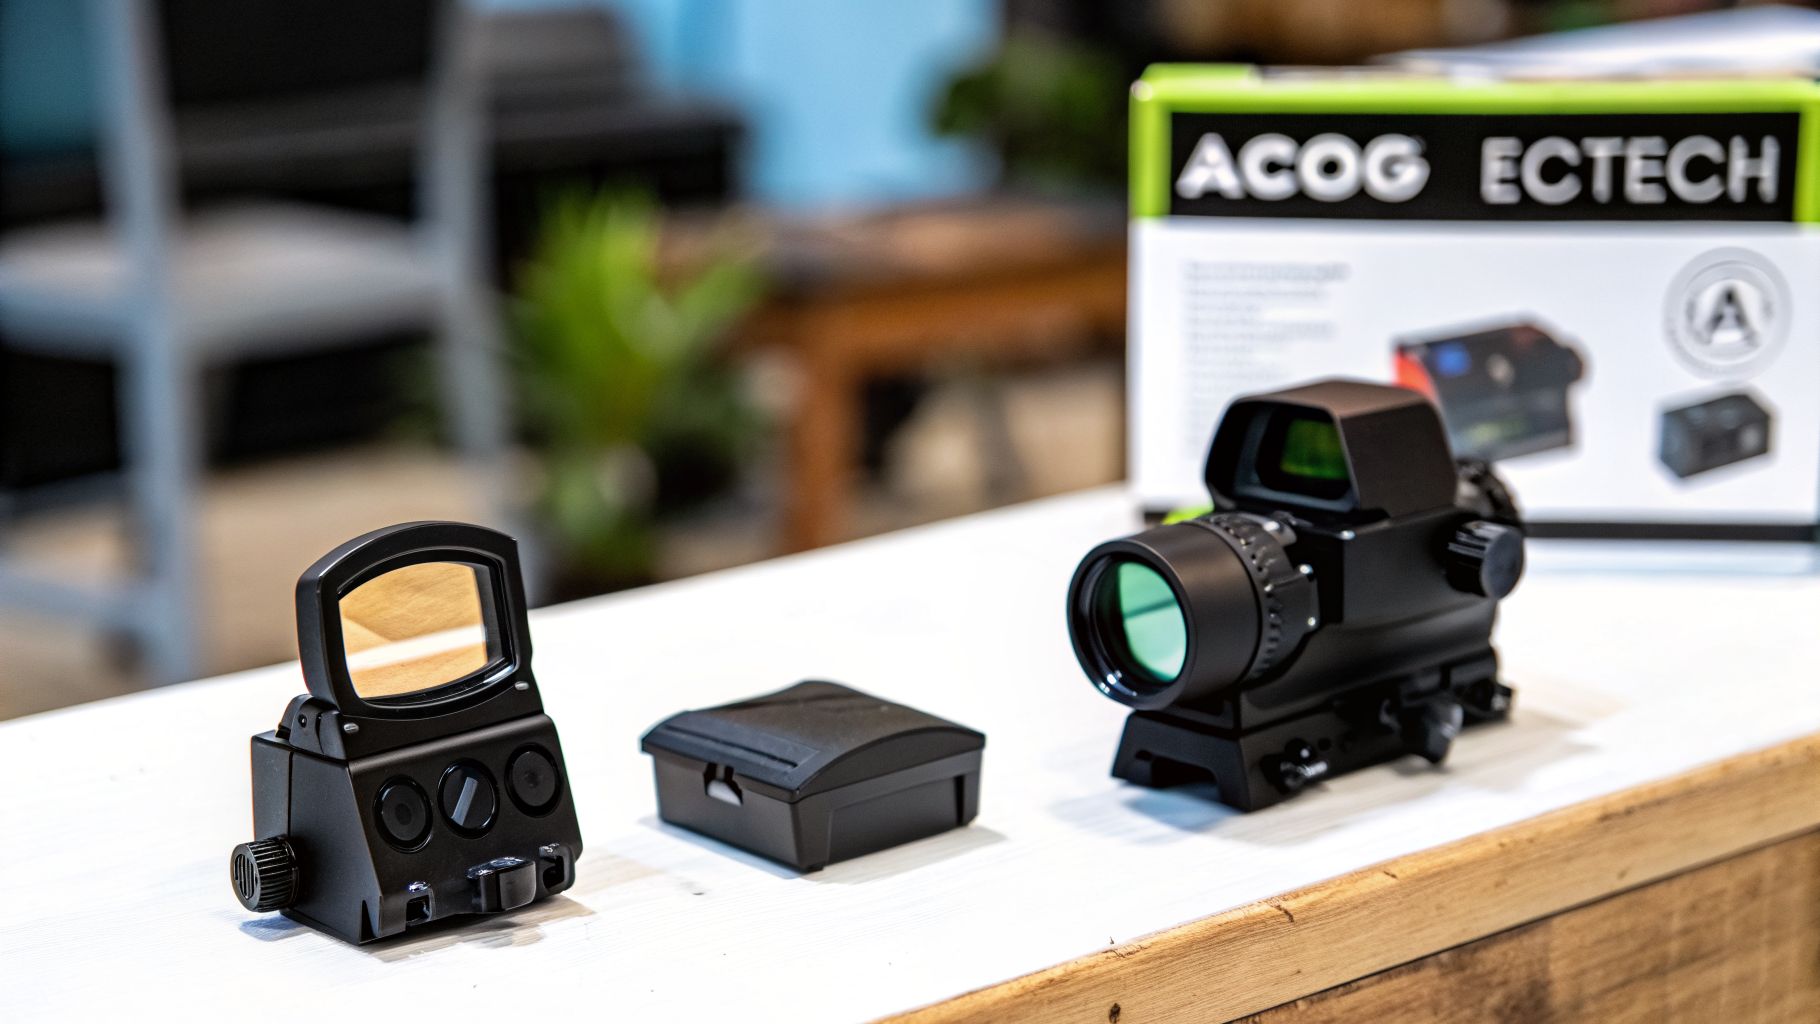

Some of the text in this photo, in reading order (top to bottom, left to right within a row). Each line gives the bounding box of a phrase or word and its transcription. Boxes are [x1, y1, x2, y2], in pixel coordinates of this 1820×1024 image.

[1177, 132, 1779, 204] ACOG ECTECH
[1701, 284, 1760, 347] A
